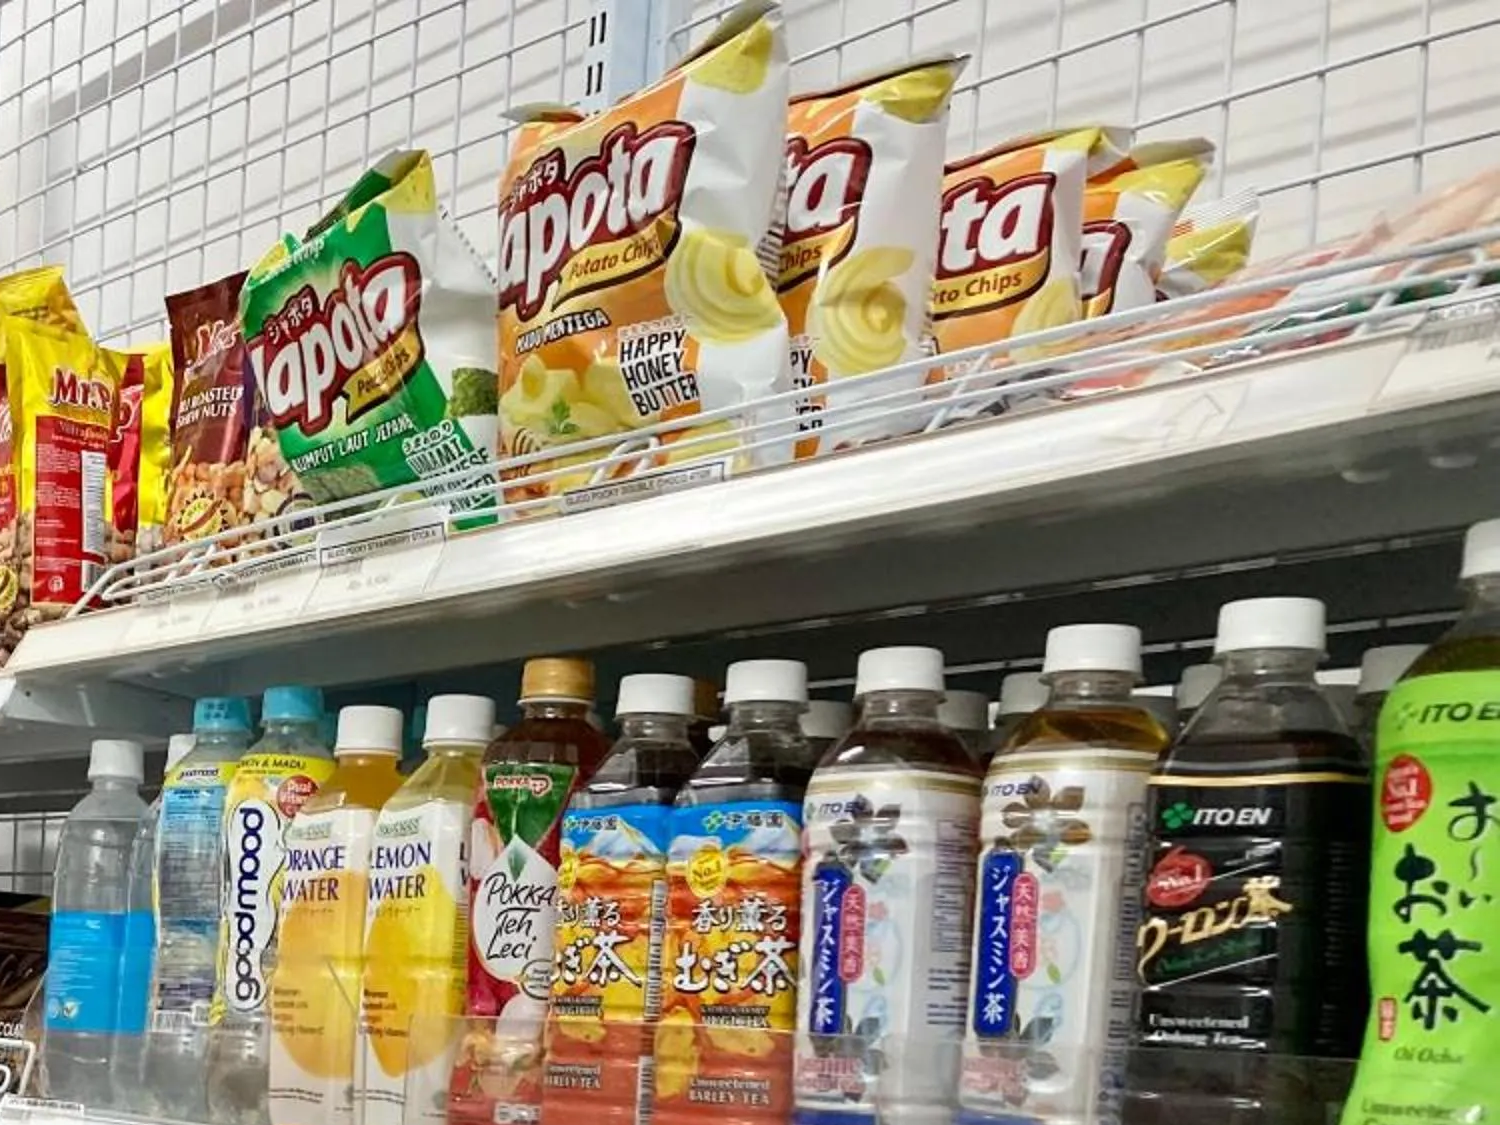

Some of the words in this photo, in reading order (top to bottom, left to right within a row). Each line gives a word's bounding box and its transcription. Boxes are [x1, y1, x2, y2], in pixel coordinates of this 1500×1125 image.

[499, 134, 680, 303] apota
[964, 271, 1022, 299] Chips
[621, 330, 687, 362] HAPPY
[623, 352, 684, 386] HONEY
[632, 376, 699, 416] BUTTER
[338, 430, 369, 455] LAUT
[1193, 808, 1235, 825] ITO
[1235, 808, 1272, 825] EN
[281, 877, 340, 901] WATER
[368, 873, 426, 901] WATER
[484, 873, 556, 906] POKKA
[234, 807, 264, 1001] goodmood
[693, 897, 787, 936] 香り薫る
[497, 906, 541, 937] Teh
[1394, 843, 1492, 1030] お茶
[486, 931, 537, 961] Leci
[814, 868, 841, 1030] ジャスミン茶
[982, 862, 1012, 1028] ジャスミン茶
[673, 936, 797, 997] むぎ茶
[688, 1090, 735, 1104] BARLEY
[742, 1092, 770, 1105] TEA
